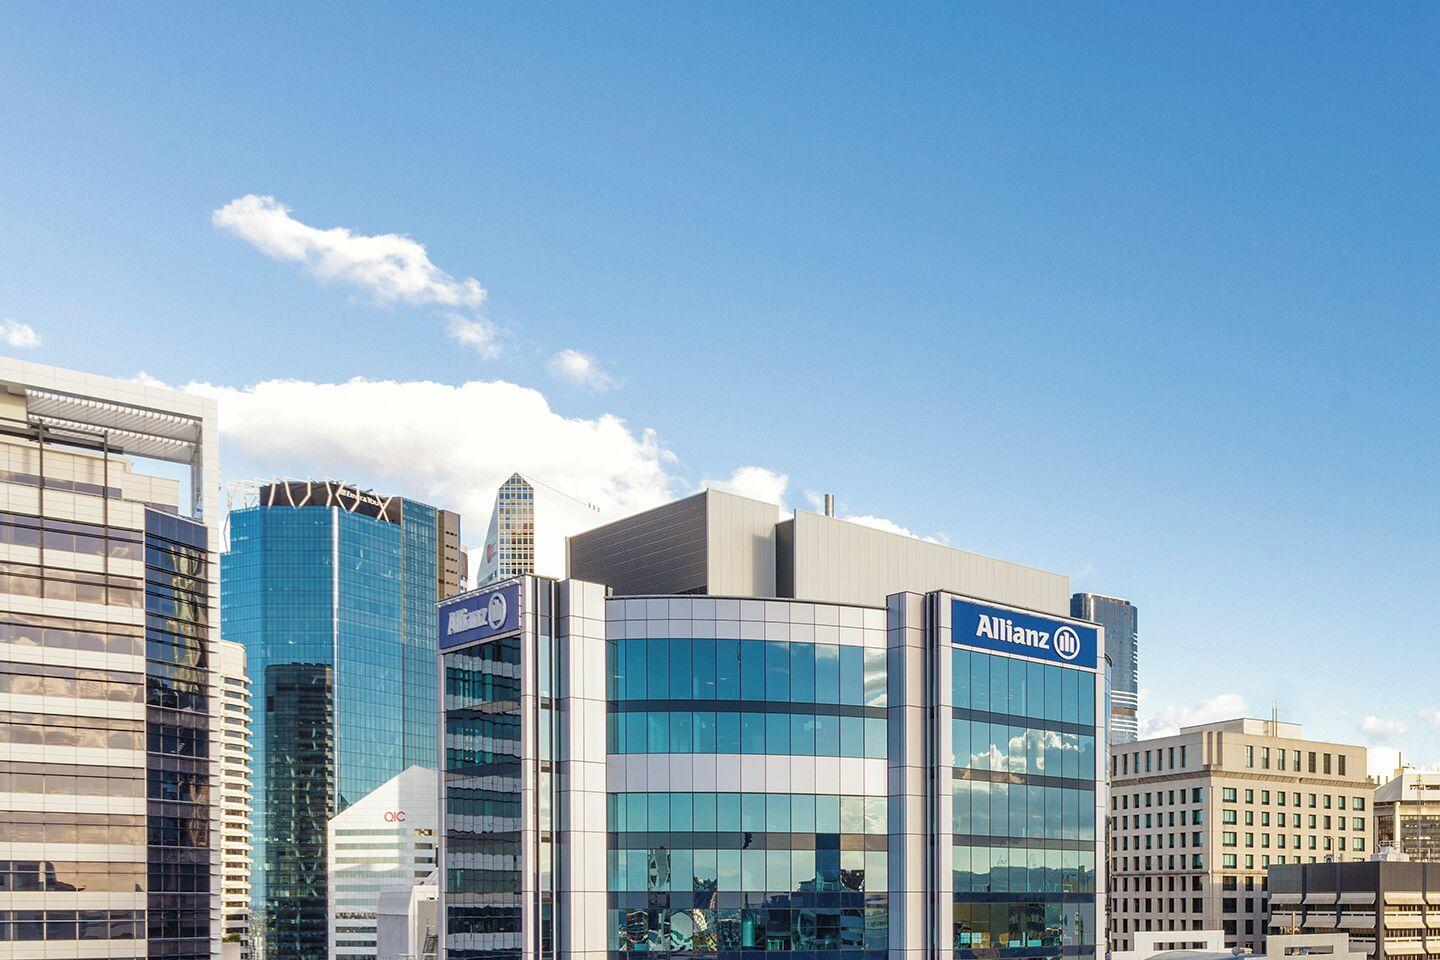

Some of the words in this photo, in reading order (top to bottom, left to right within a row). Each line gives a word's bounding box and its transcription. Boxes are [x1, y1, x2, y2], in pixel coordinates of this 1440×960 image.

[447, 607, 488, 635] Allianz
[975, 613, 1050, 650] Allianz
[384, 811, 406, 822] QIC
